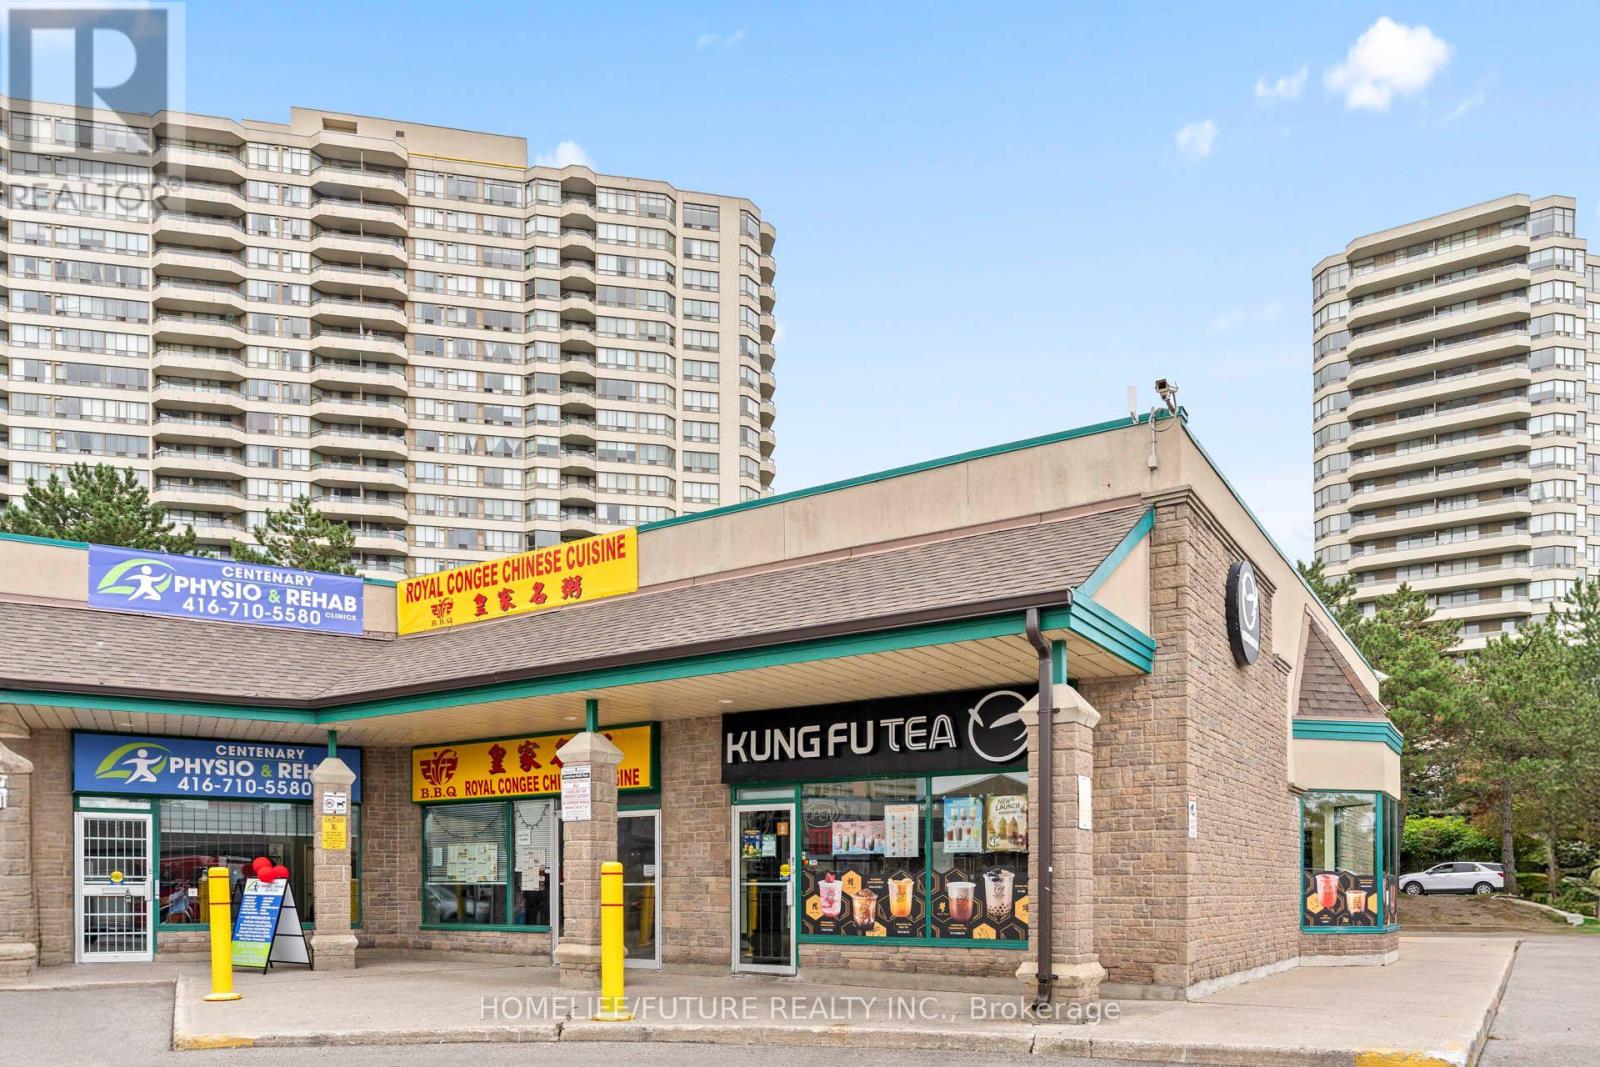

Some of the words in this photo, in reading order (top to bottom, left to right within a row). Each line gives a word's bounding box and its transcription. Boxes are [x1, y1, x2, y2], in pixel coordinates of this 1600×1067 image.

[222, 566, 315, 587] CENTENARY
[406, 581, 444, 604] ROYAL
[446, 563, 499, 595] CONGEE
[502, 549, 562, 583] CHINESE
[566, 534, 626, 570] CUISINE
[174, 575, 262, 601] PHYSIO
[269, 589, 281, 604] &
[286, 589, 357, 612] REHAB
[182, 597, 321, 625] 416-710-5580
[325, 611, 357, 621] CLINICS
[726, 725, 821, 763] KUNG
[828, 720, 874, 756] FU
[880, 714, 957, 752] TEA
[215, 745, 305, 760] CENTENARY
[170, 756, 254, 777] PHYSIO
[261, 764, 272, 778] &
[278, 762, 317, 779] REH
[177, 776, 312, 796] 416-710-5580
[465, 778, 496, 796] ROYAL
[498, 775, 539, 793] CONGEE
